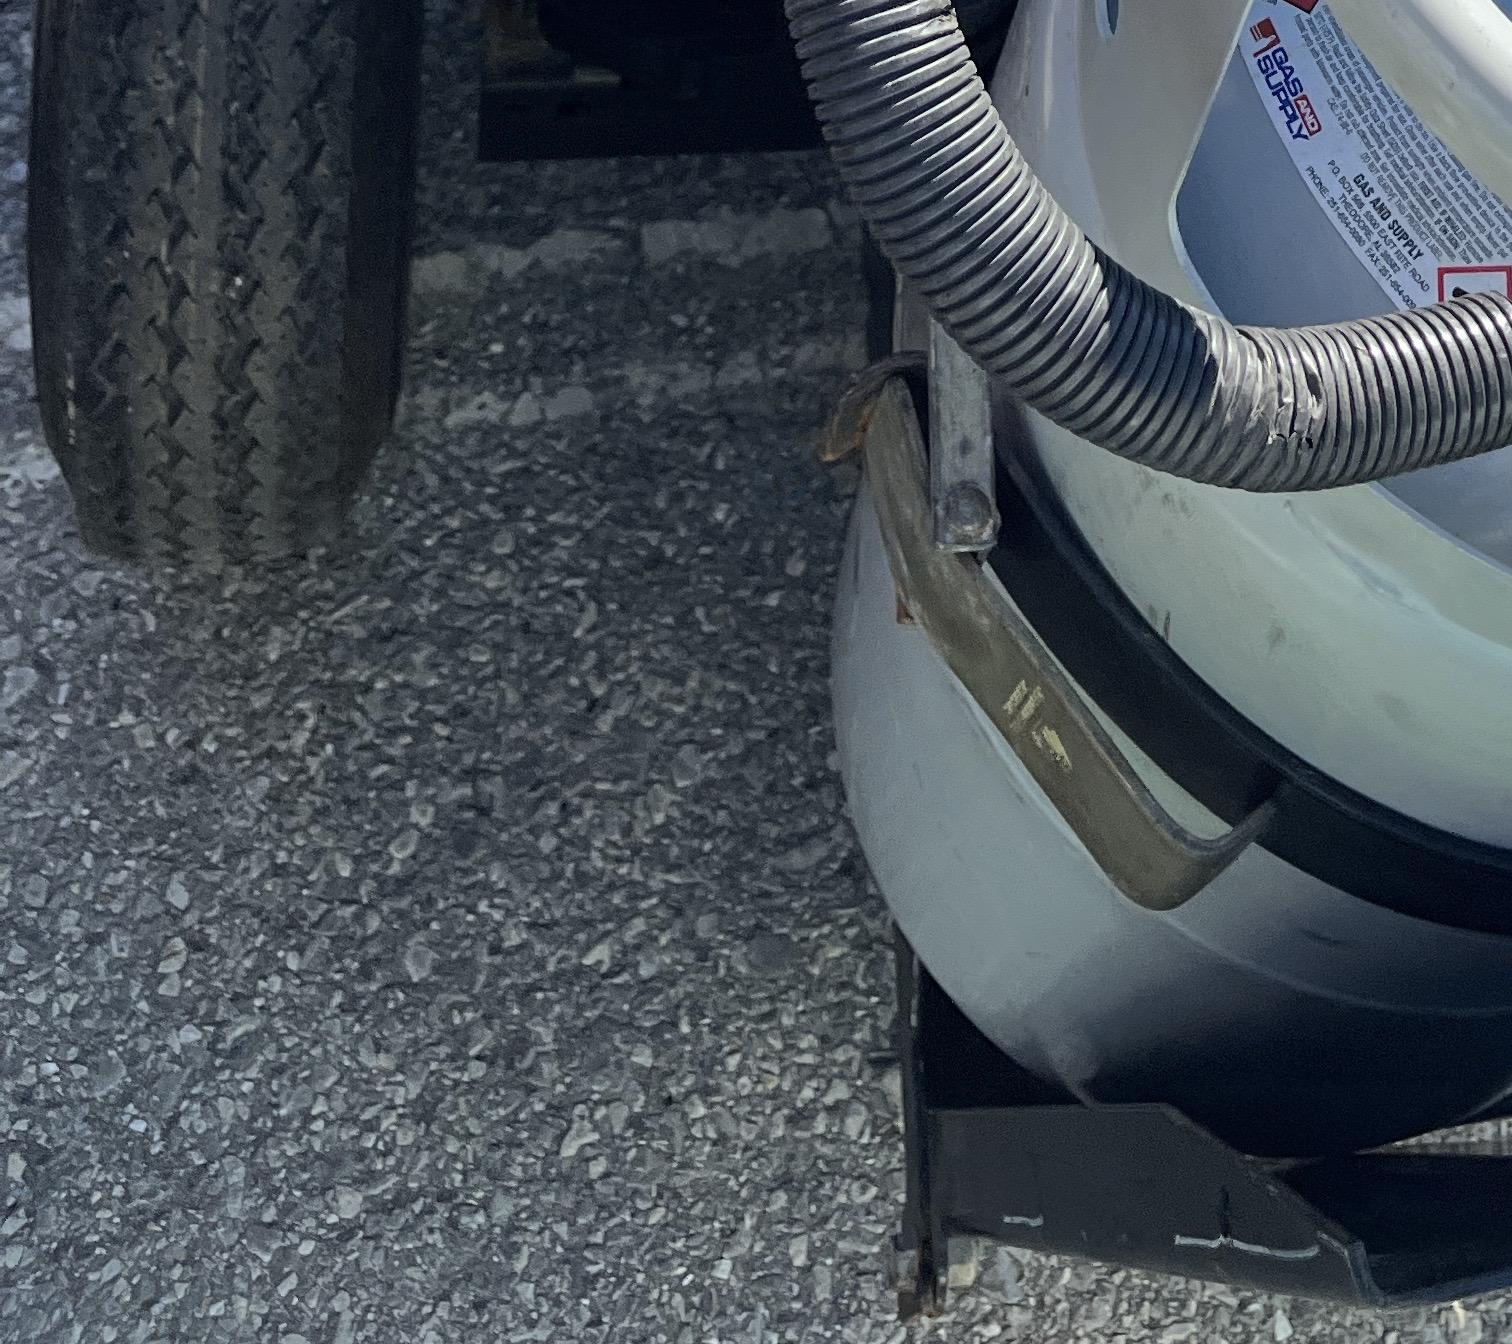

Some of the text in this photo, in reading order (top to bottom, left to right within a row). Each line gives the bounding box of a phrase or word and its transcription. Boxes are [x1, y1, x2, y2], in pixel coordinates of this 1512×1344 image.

[1256, 54, 1310, 141] SUPPLY
[1271, 46, 1320, 133] GAS AND
[1337, 176, 1355, 195] BOX
[1376, 228, 1396, 250] EAST
[1407, 268, 1430, 292] ROAD
[1351, 173, 1424, 261] GAS AND SUPPLY
